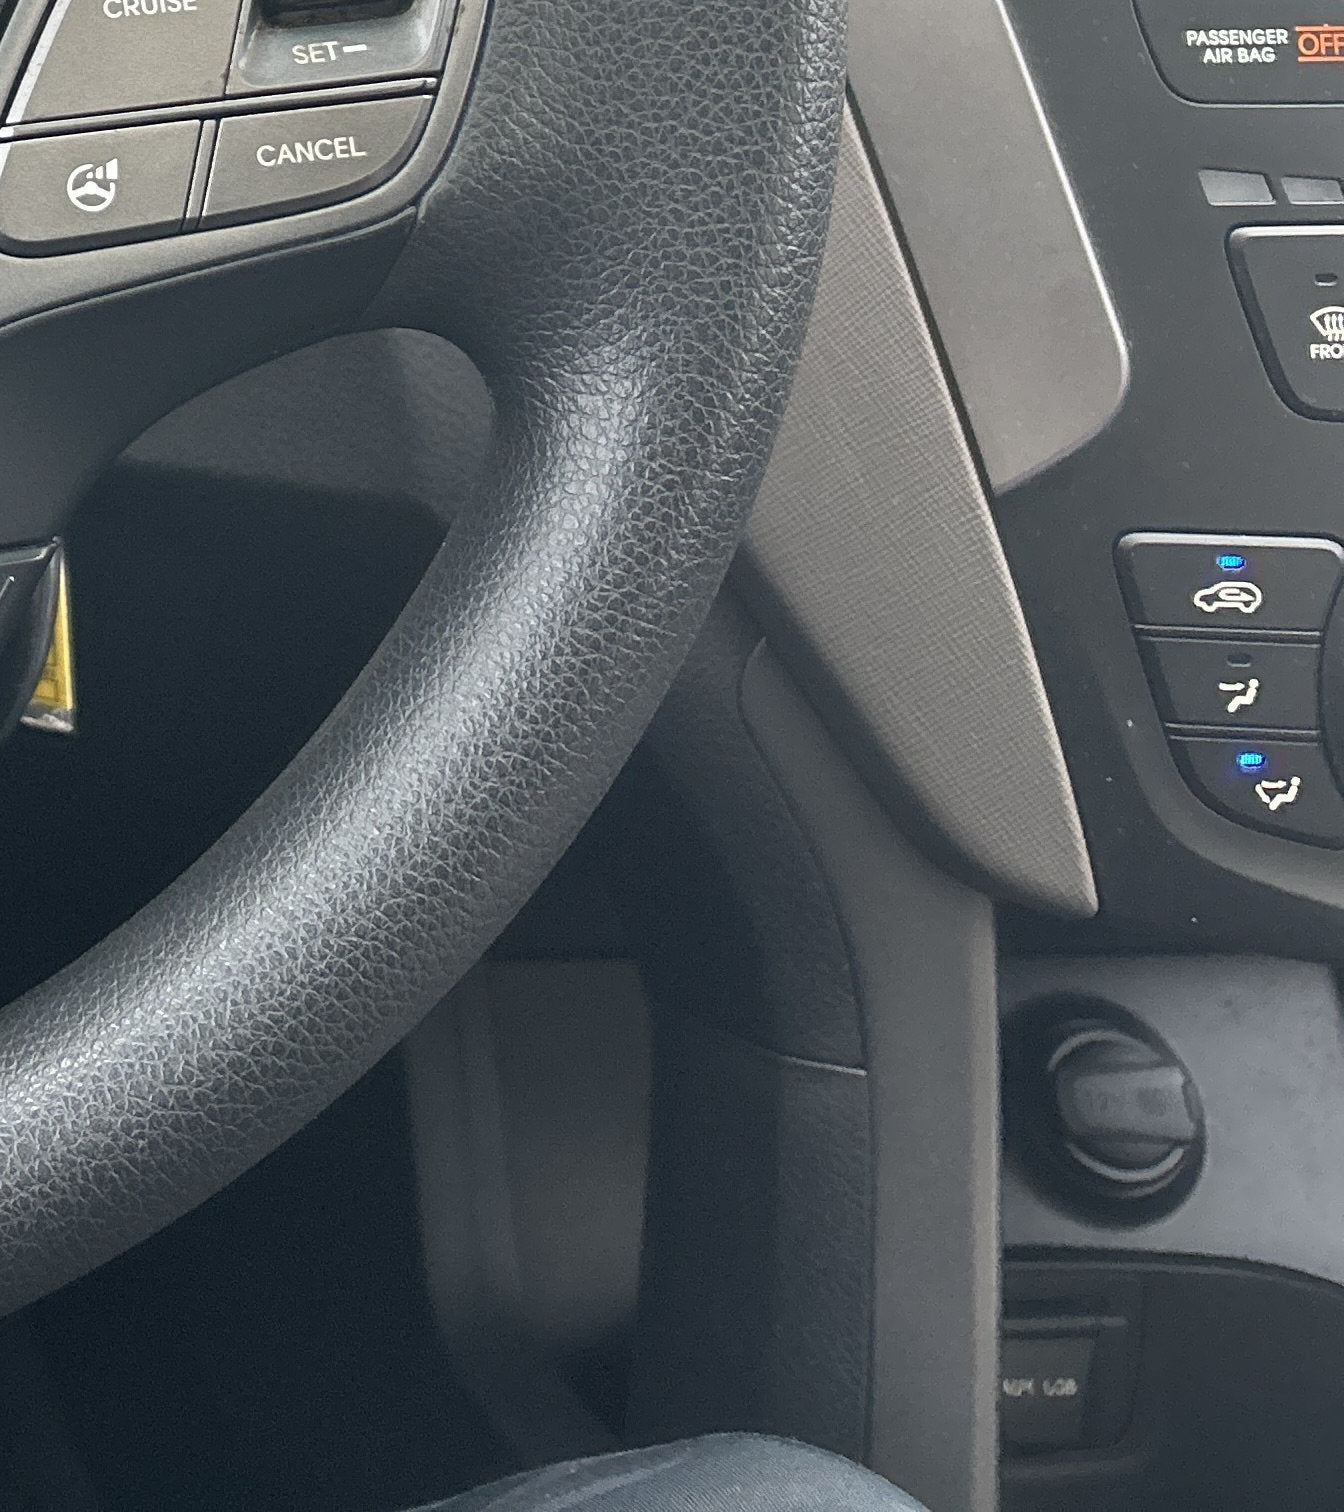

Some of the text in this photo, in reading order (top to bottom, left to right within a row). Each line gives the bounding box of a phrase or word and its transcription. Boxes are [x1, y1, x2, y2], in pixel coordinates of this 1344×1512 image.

[1186, 29, 1289, 46] PASSENGER
[1297, 33, 1344, 56] OFF
[1203, 48, 1276, 63] AIR BAG
[256, 136, 367, 167] CANCEL
